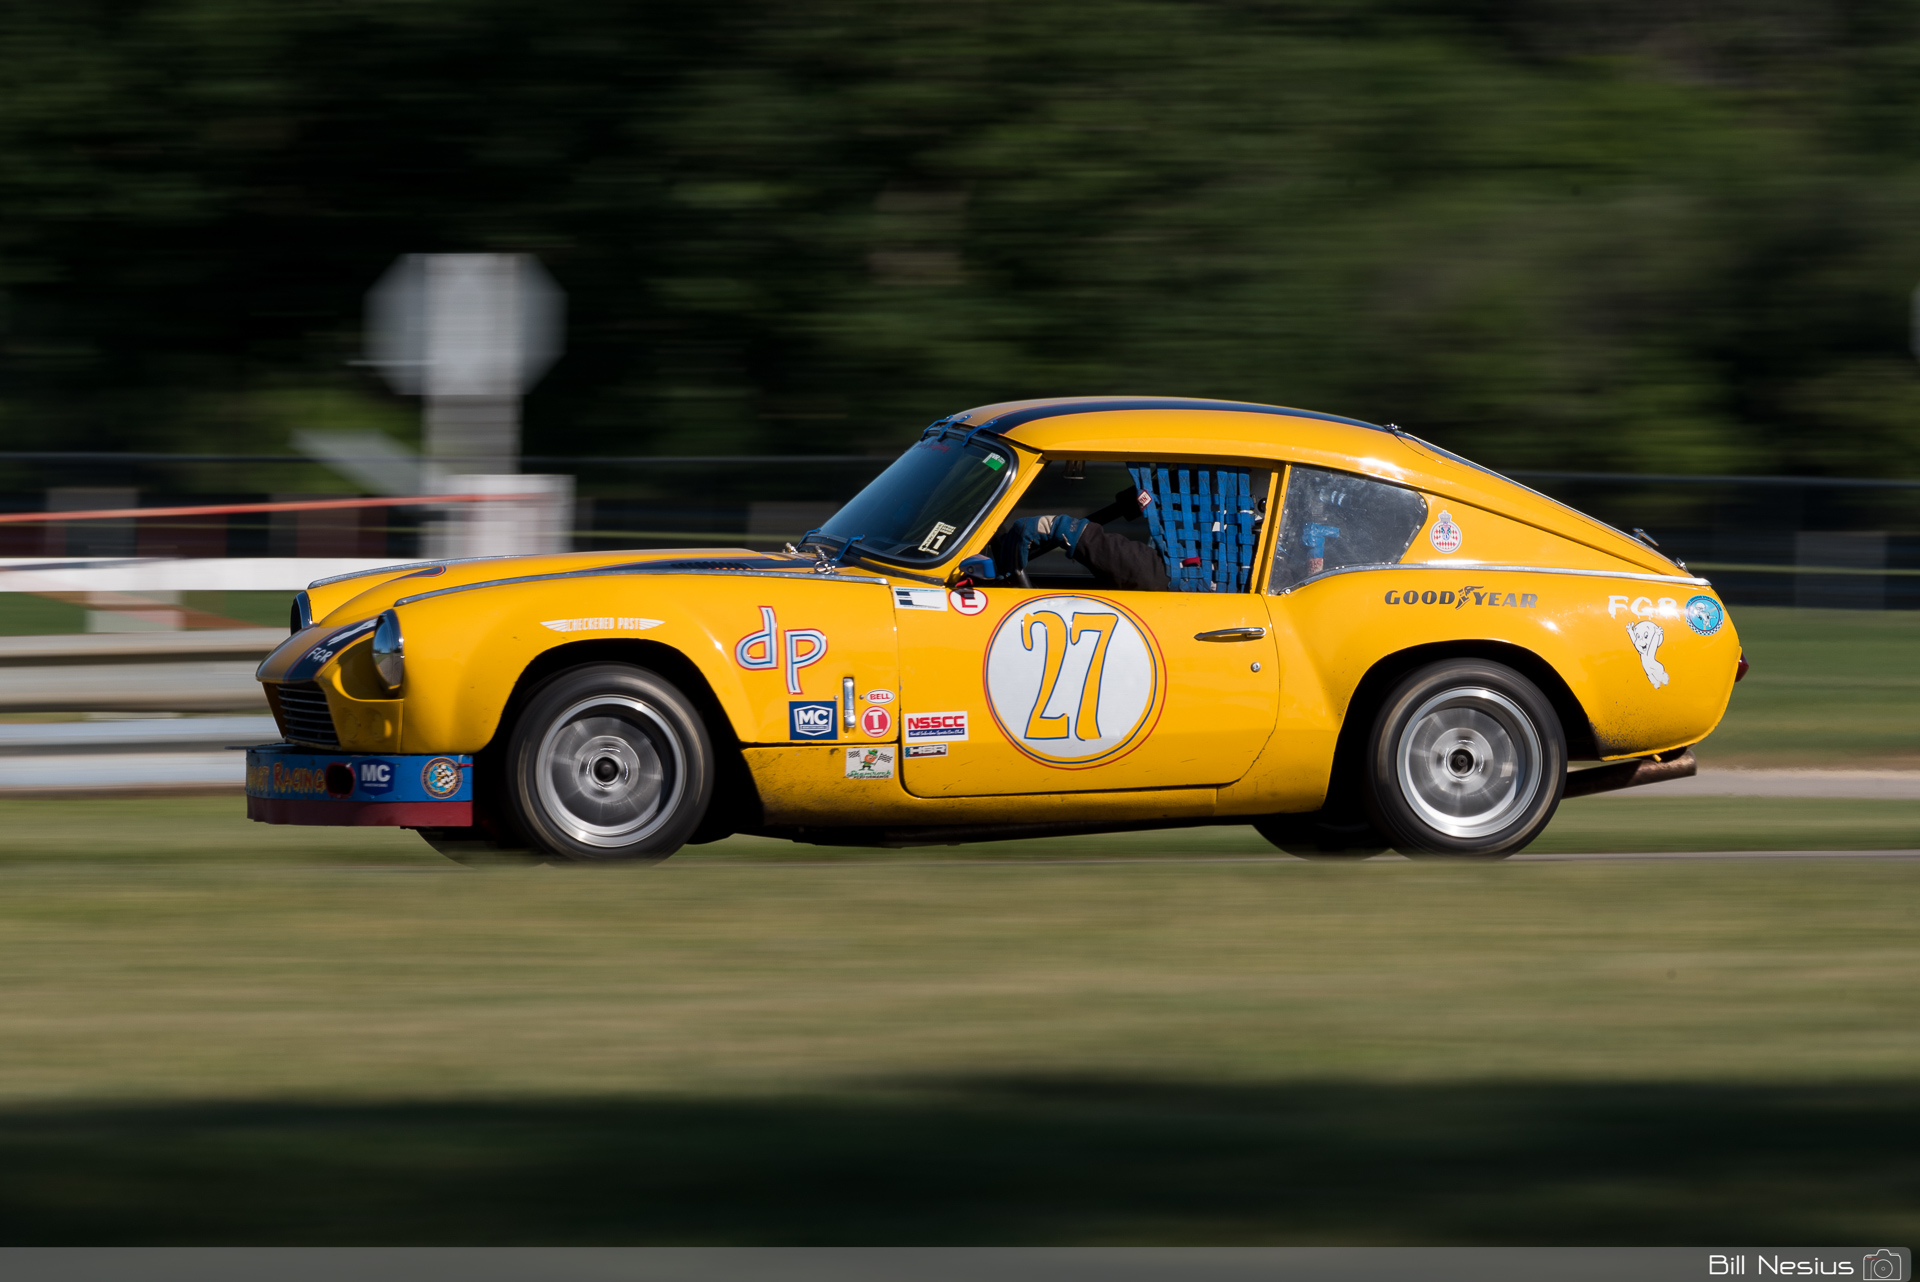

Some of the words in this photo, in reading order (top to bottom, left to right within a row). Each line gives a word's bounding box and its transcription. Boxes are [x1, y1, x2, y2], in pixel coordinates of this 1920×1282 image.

[1608, 595, 1680, 621] FGR
[568, 617, 615, 631] CHECKERED
[617, 617, 640, 630] PAST
[306, 647, 333, 663] FGR
[735, 605, 828, 695] dp
[1021, 610, 1119, 741] 27
[869, 692, 891, 700] BELL
[798, 710, 829, 725] MC
[908, 715, 965, 729] NSSCC
[361, 764, 391, 782] MC
